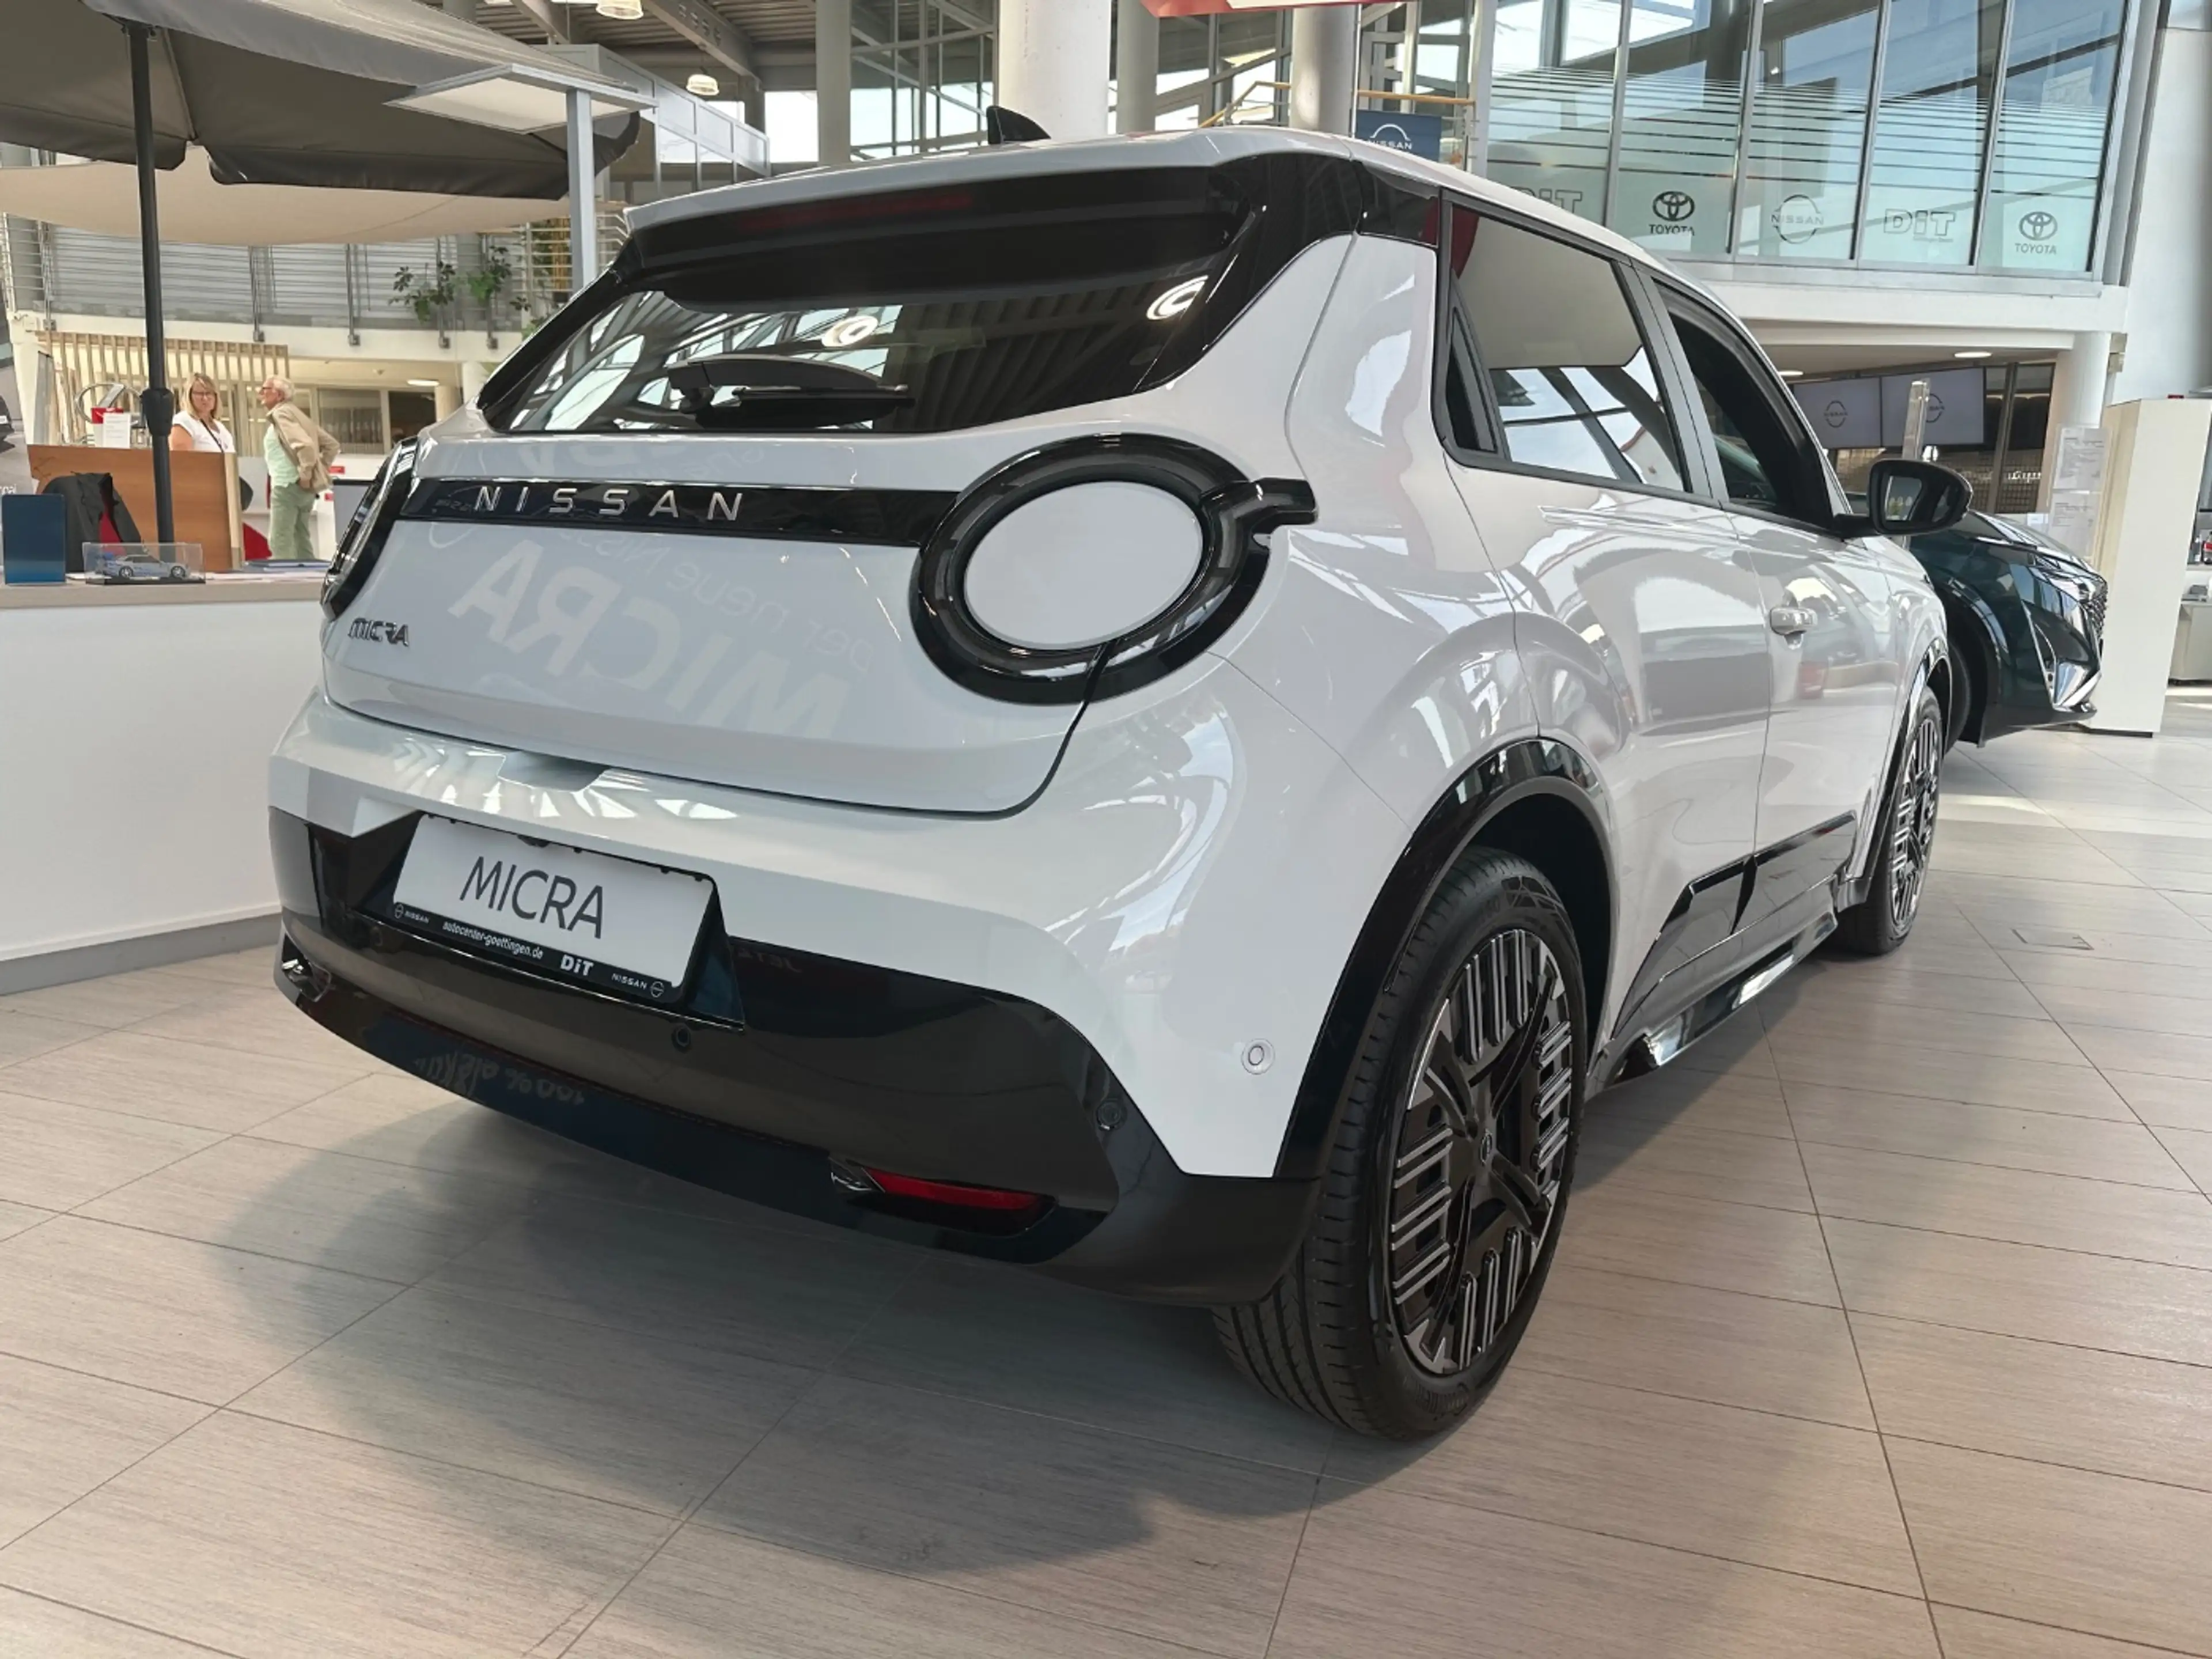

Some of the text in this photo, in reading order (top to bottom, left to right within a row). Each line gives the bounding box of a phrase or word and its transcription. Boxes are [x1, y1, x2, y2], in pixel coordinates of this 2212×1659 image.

[1369, 141, 1412, 150] SSAN
[1771, 214, 1824, 225] NISSAN
[1884, 208, 1956, 236] DiT
[1649, 224, 1695, 237] TOYOTA
[2015, 243, 2057, 255] TOYOTA
[474, 486, 744, 521] NISSAN
[347, 616, 409, 647] MICRA
[459, 855, 603, 940] MICRA
[404, 910, 430, 923] NISSAN
[442, 921, 594, 976] autocenter-goettingen.de DiT
[611, 973, 647, 990] NISSAN
